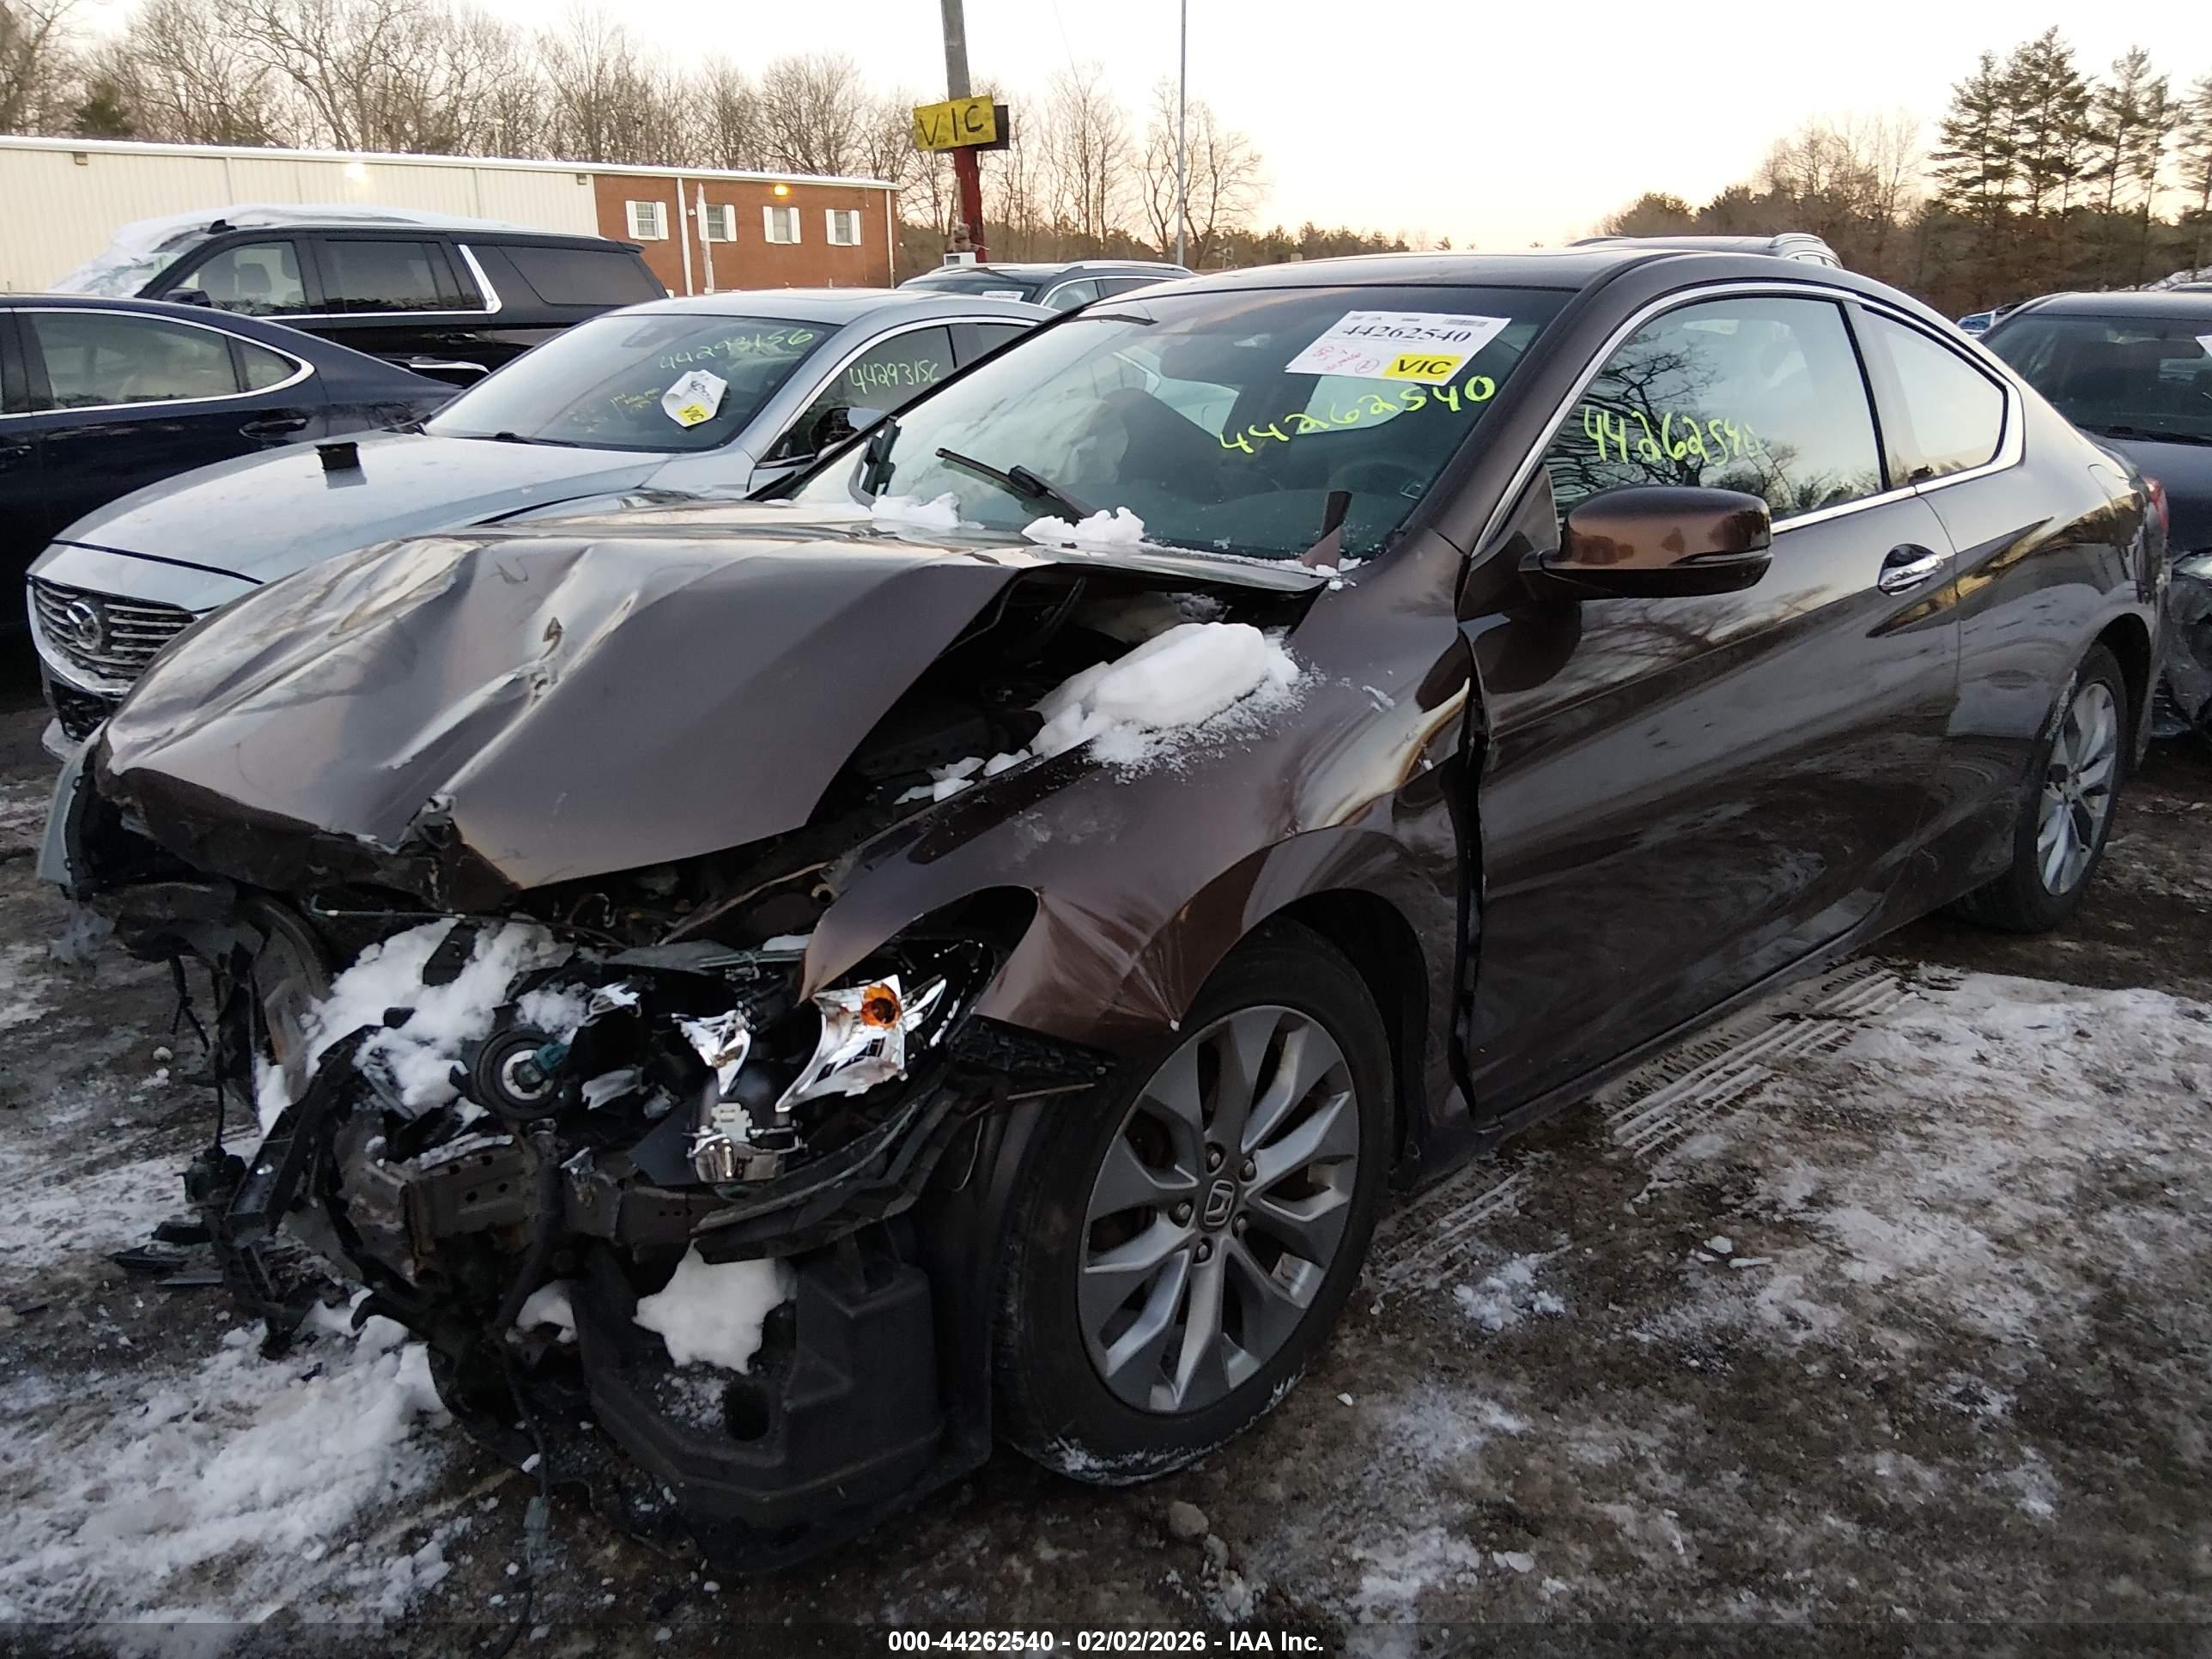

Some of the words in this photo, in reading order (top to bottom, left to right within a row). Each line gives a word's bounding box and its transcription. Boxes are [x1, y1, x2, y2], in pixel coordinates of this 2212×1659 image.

[919, 105, 984, 146] VIC
[1342, 325, 1472, 343] 44262540
[848, 359, 940, 395] 44293156
[1398, 359, 1452, 374] VIC
[684, 405, 704, 422] VIC
[1219, 374, 1495, 454] 44262540
[1583, 405, 1759, 466] 44262540
